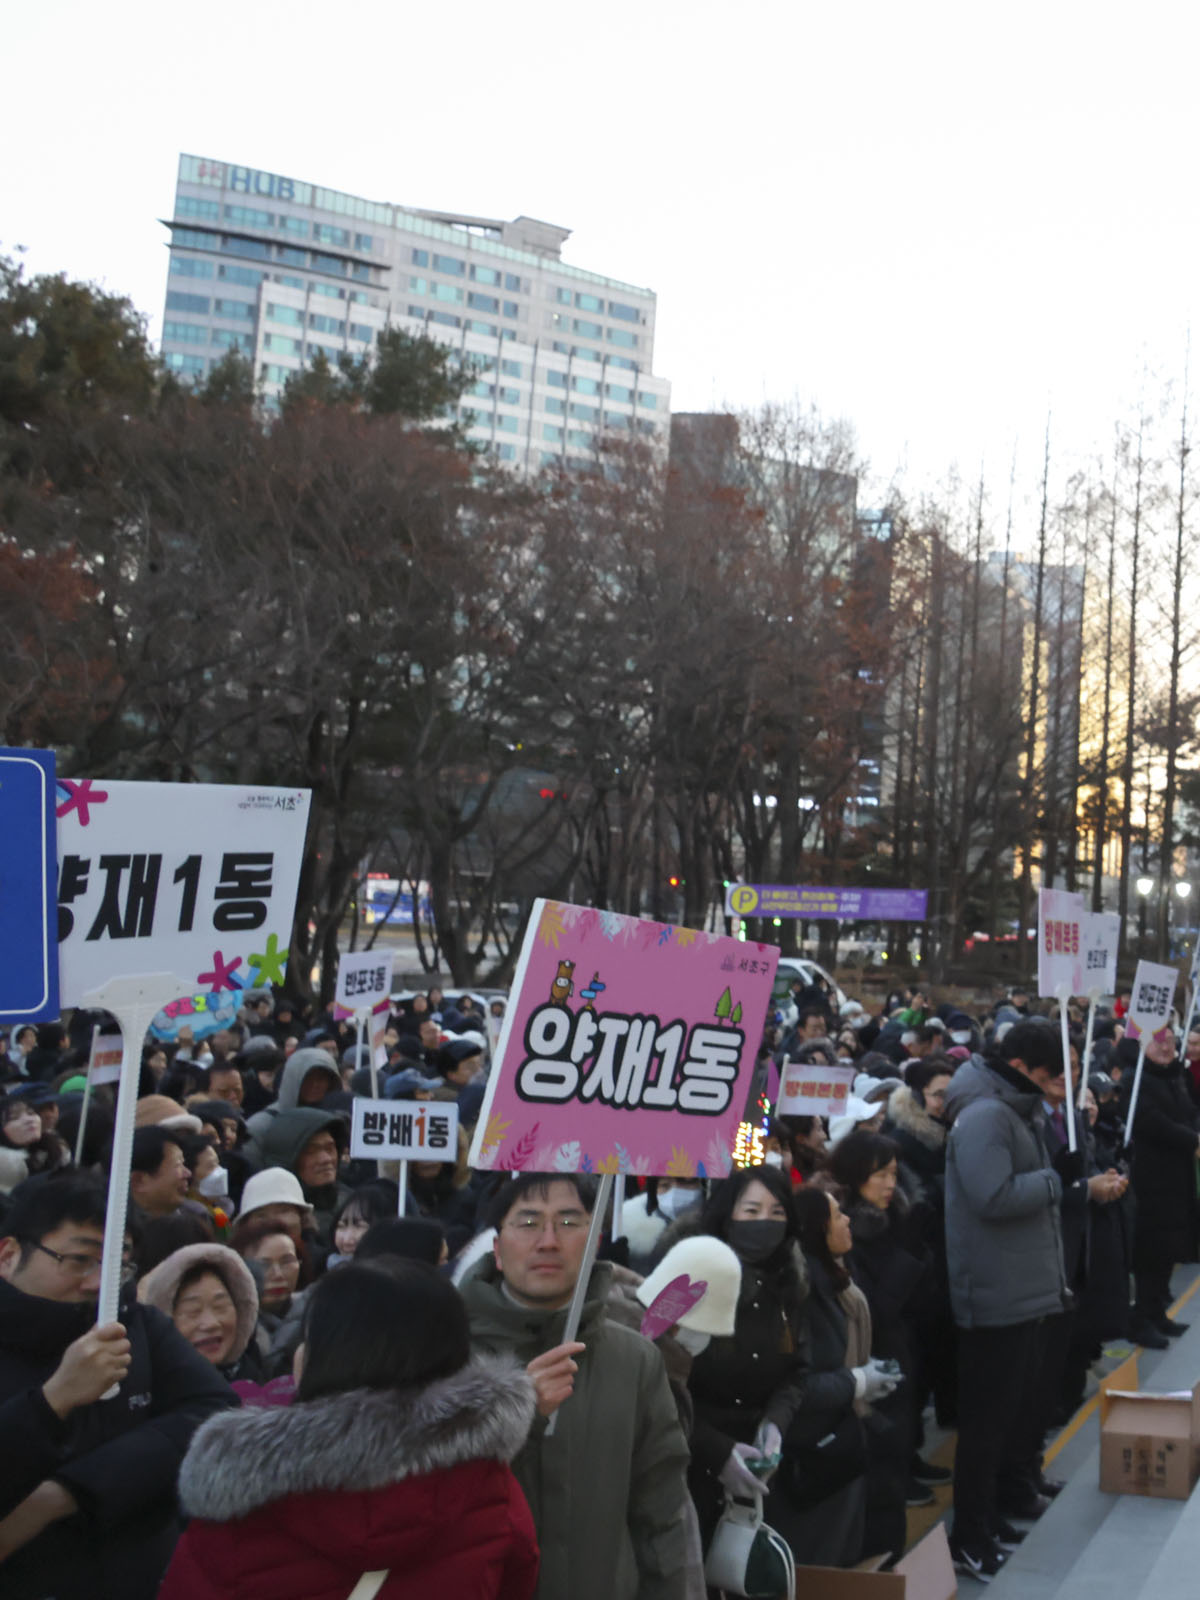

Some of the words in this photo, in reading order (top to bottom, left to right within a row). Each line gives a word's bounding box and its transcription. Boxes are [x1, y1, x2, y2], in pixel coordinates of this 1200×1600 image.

[231, 166, 295, 200] HUB
[737, 957, 770, 976] 서초구
[515, 1001, 745, 1117] 양재1동
[362, 1109, 449, 1149] 방배1동
